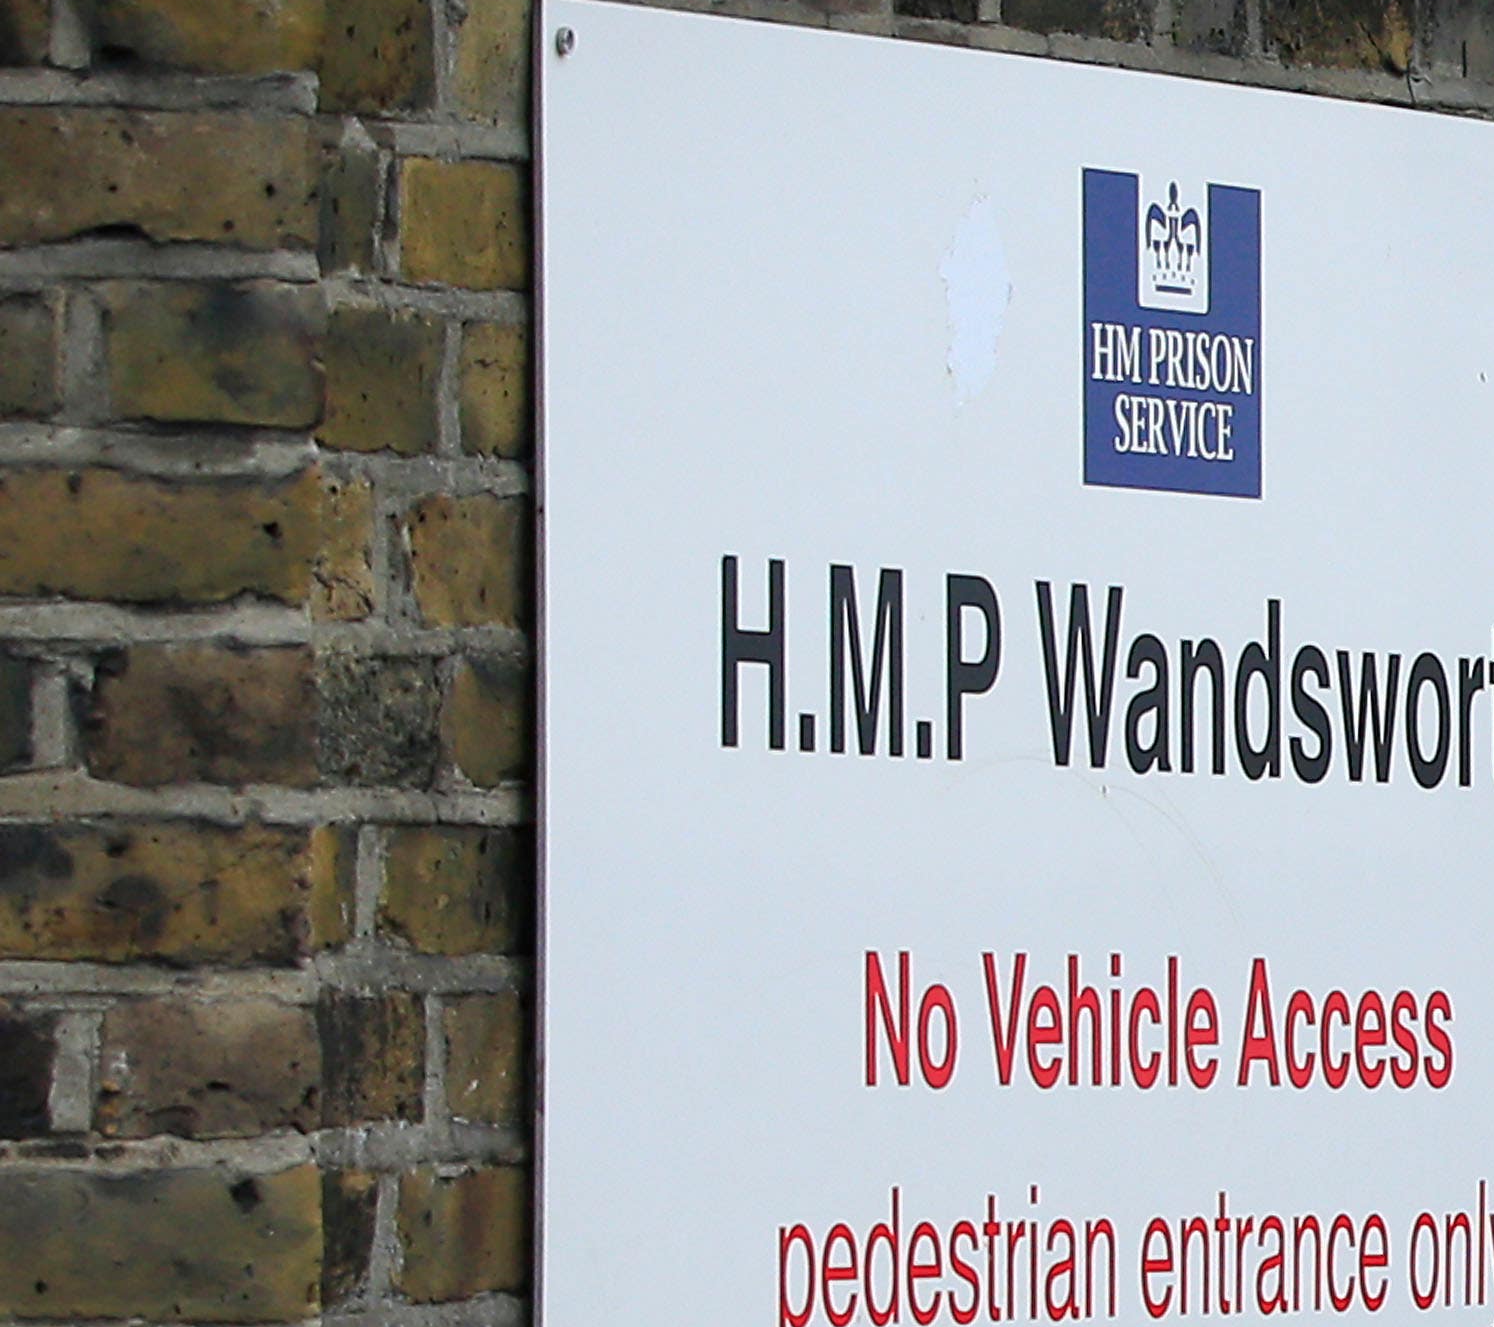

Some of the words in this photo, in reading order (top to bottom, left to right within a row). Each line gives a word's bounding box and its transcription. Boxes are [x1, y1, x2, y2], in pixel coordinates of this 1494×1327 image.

[1091, 322, 1142, 383] HM
[1148, 328, 1254, 395] PRISON
[1114, 394, 1233, 460] SERVICE
[720, 554, 1002, 761] H.M.P
[865, 950, 958, 1090] No
[982, 952, 1219, 1090] Vehicle
[1237, 957, 1453, 1090] Access
[1140, 1191, 1389, 1319] entrance
